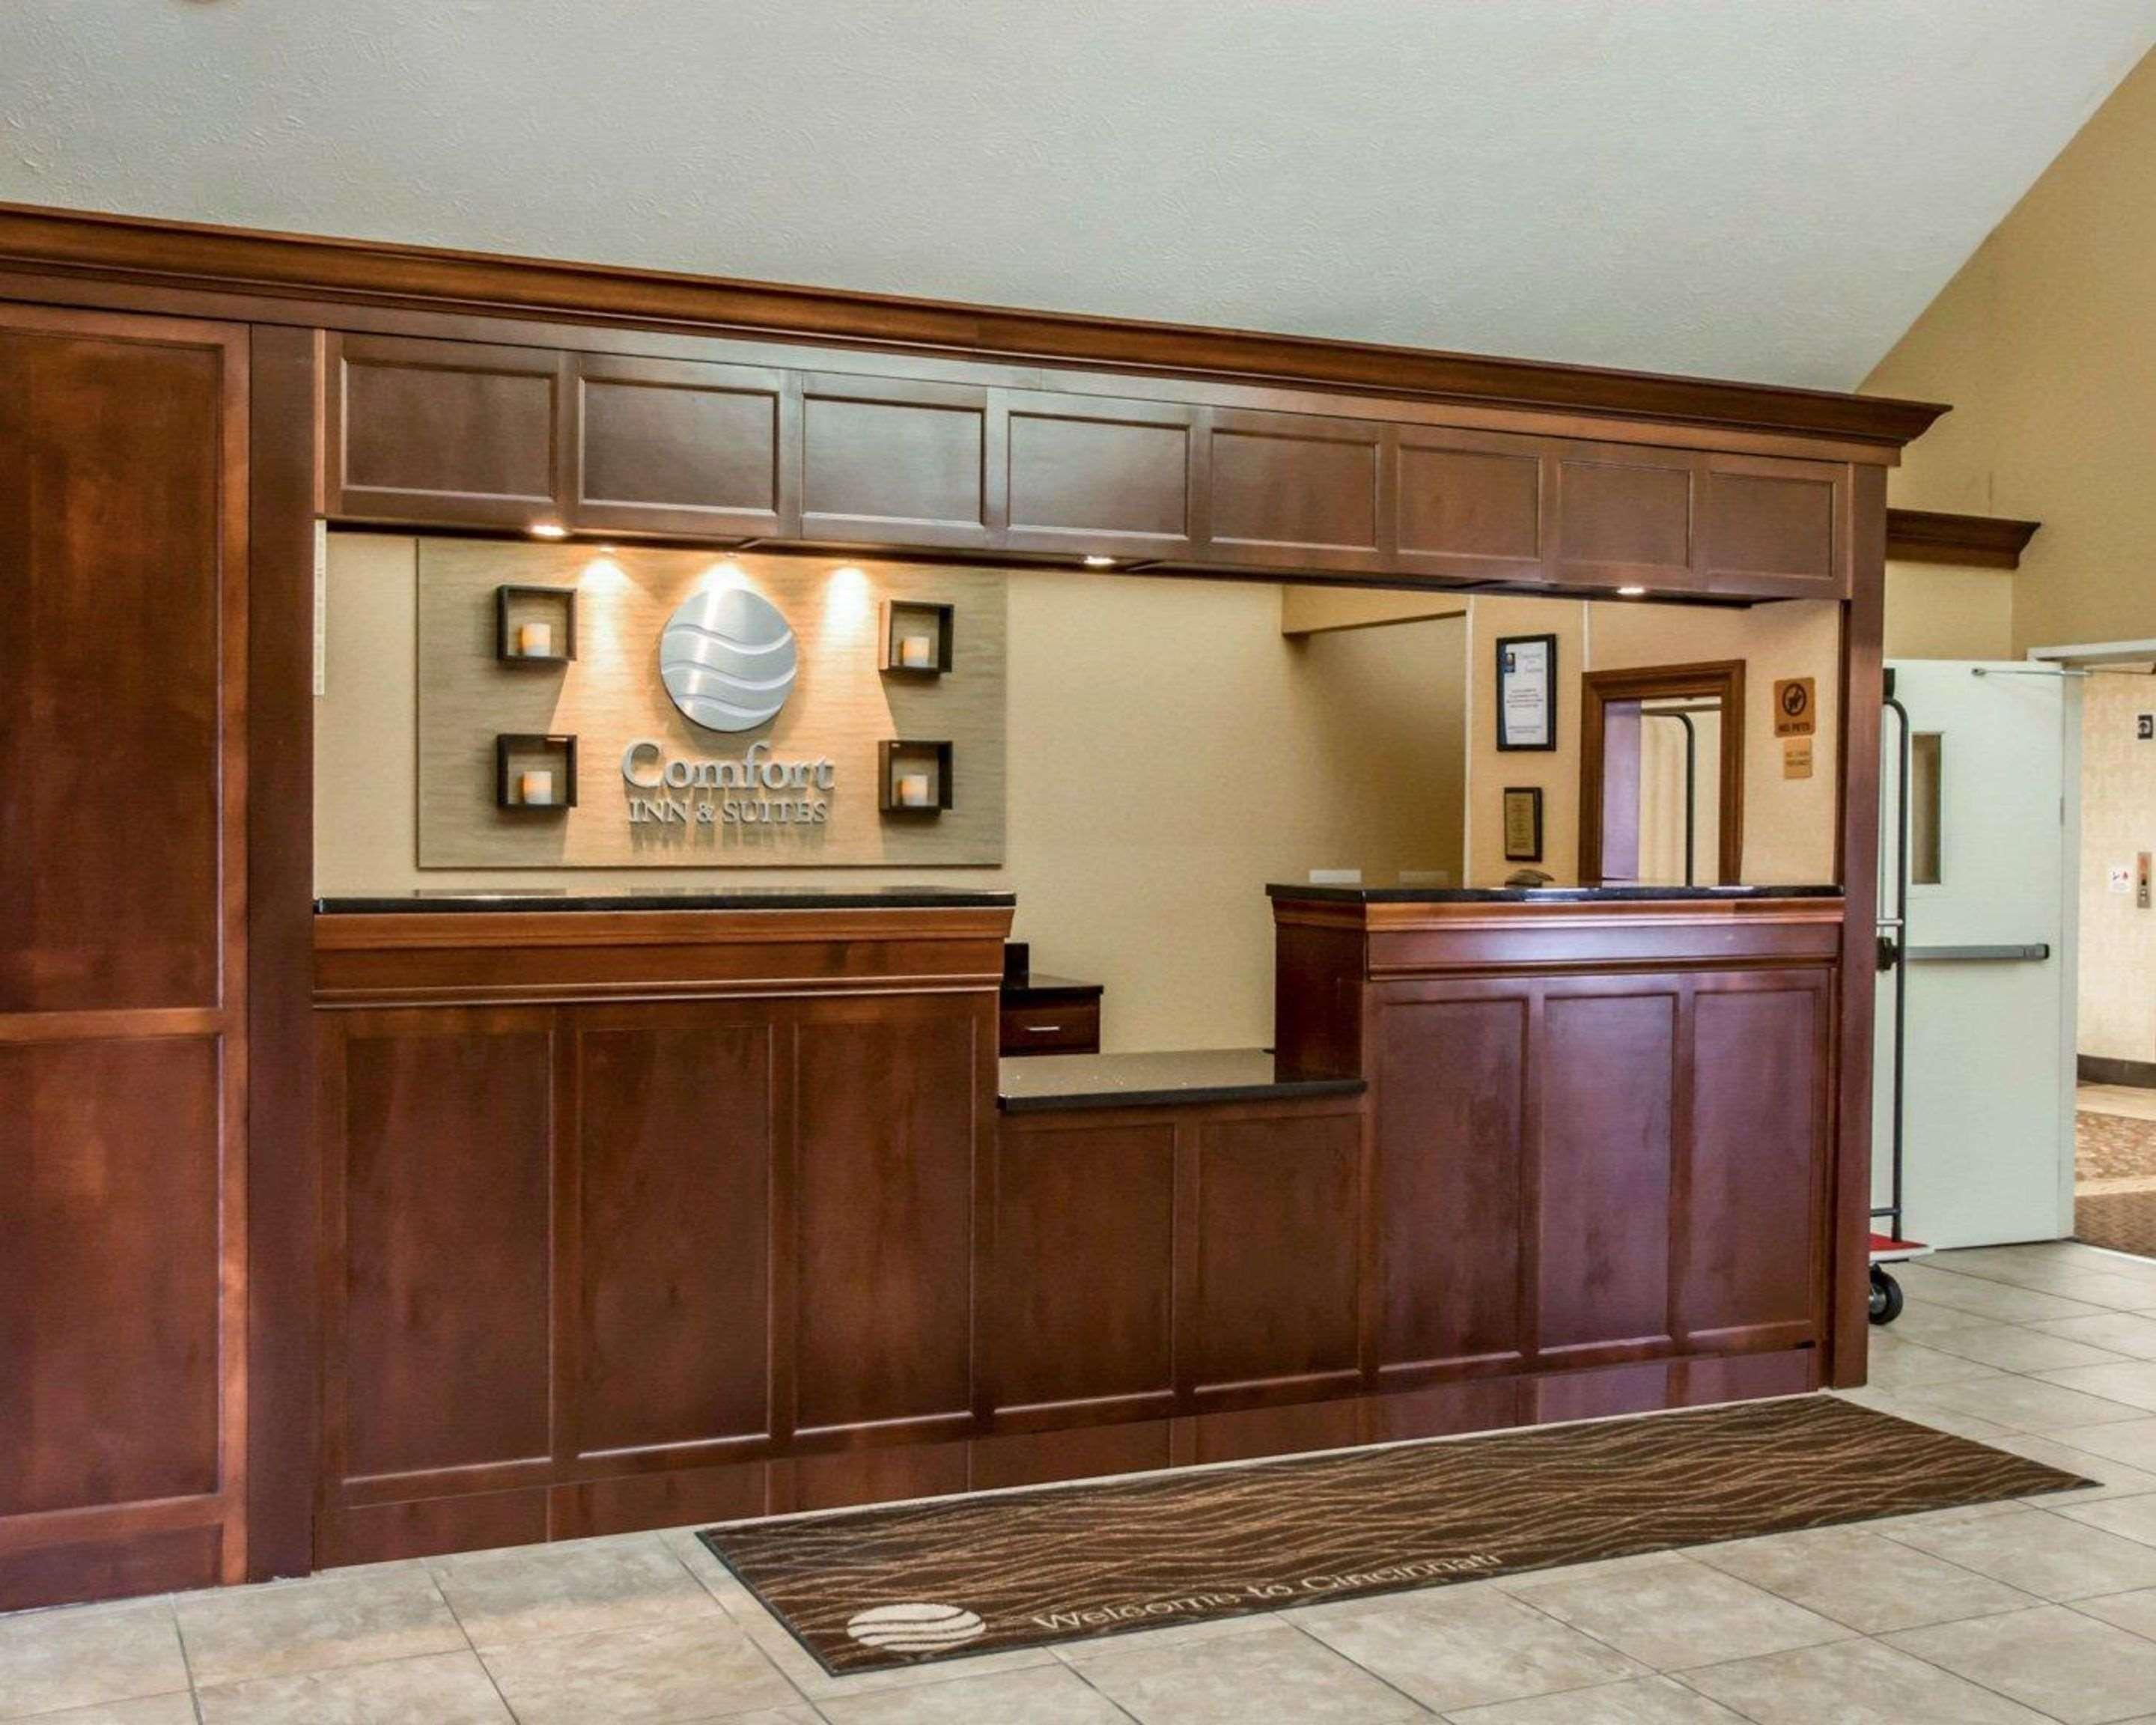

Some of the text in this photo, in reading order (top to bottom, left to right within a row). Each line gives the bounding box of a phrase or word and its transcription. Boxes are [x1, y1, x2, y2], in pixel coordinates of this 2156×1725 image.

[622, 740, 835, 791] Comfort
[630, 799, 827, 823] INN & SUITES
[1032, 1552, 1502, 1631] Welcome to Cincinnati
